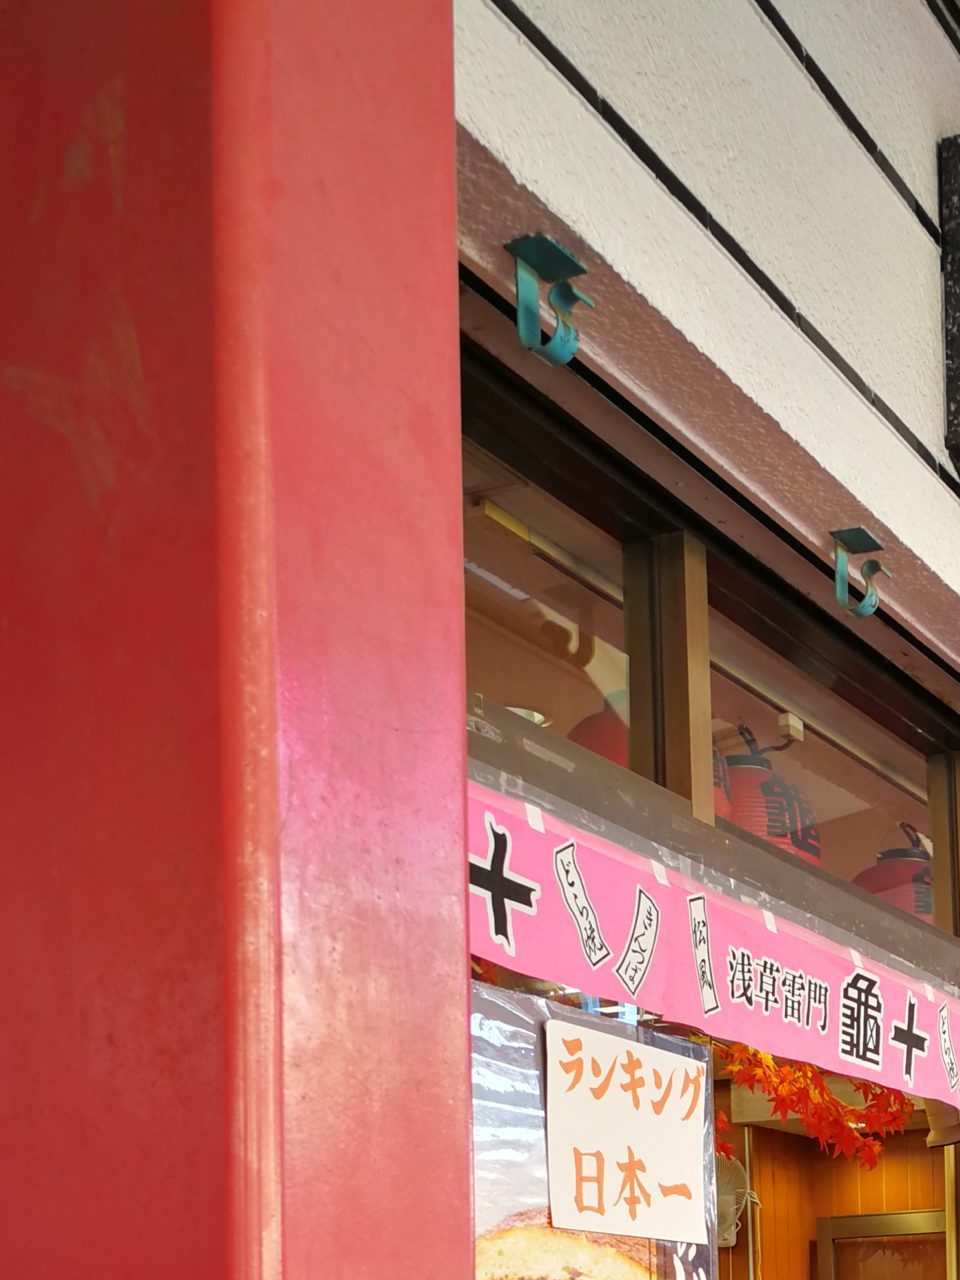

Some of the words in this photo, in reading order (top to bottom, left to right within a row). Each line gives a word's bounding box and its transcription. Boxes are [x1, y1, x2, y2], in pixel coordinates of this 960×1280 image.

[559, 858, 604, 957] どら焼
[727, 948, 830, 1032] 浅草雷門
[558, 1038, 707, 1121] ランキング
[572, 1145, 693, 1222] 日本一
